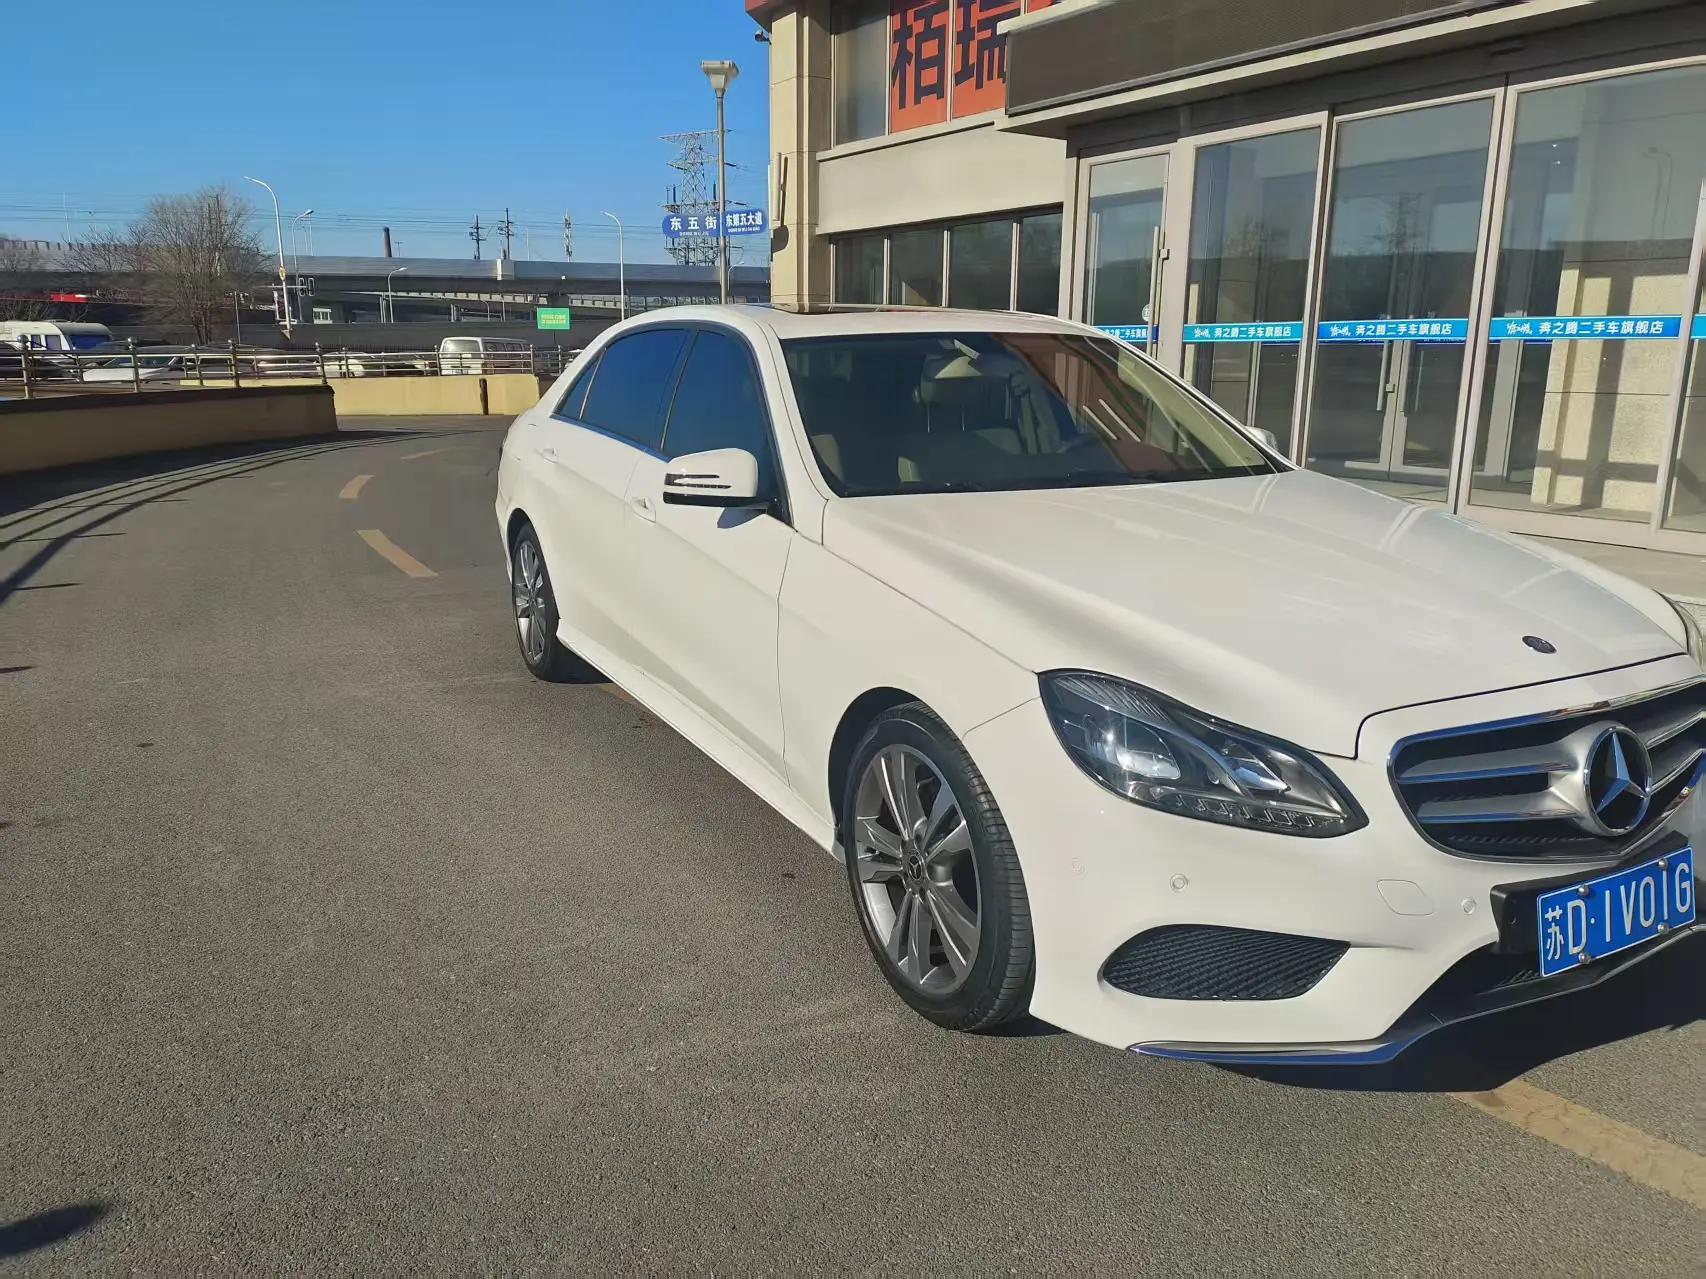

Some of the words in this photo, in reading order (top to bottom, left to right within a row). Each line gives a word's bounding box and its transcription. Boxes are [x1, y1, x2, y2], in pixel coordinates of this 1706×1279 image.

[670, 215, 717, 231] 东五街
[725, 211, 763, 227] 东第五大道
[1355, 323, 1453, 336] 奔之腾二手车旗舰店
[1538, 320, 1664, 335] 奔之腾二手车旗舰店
